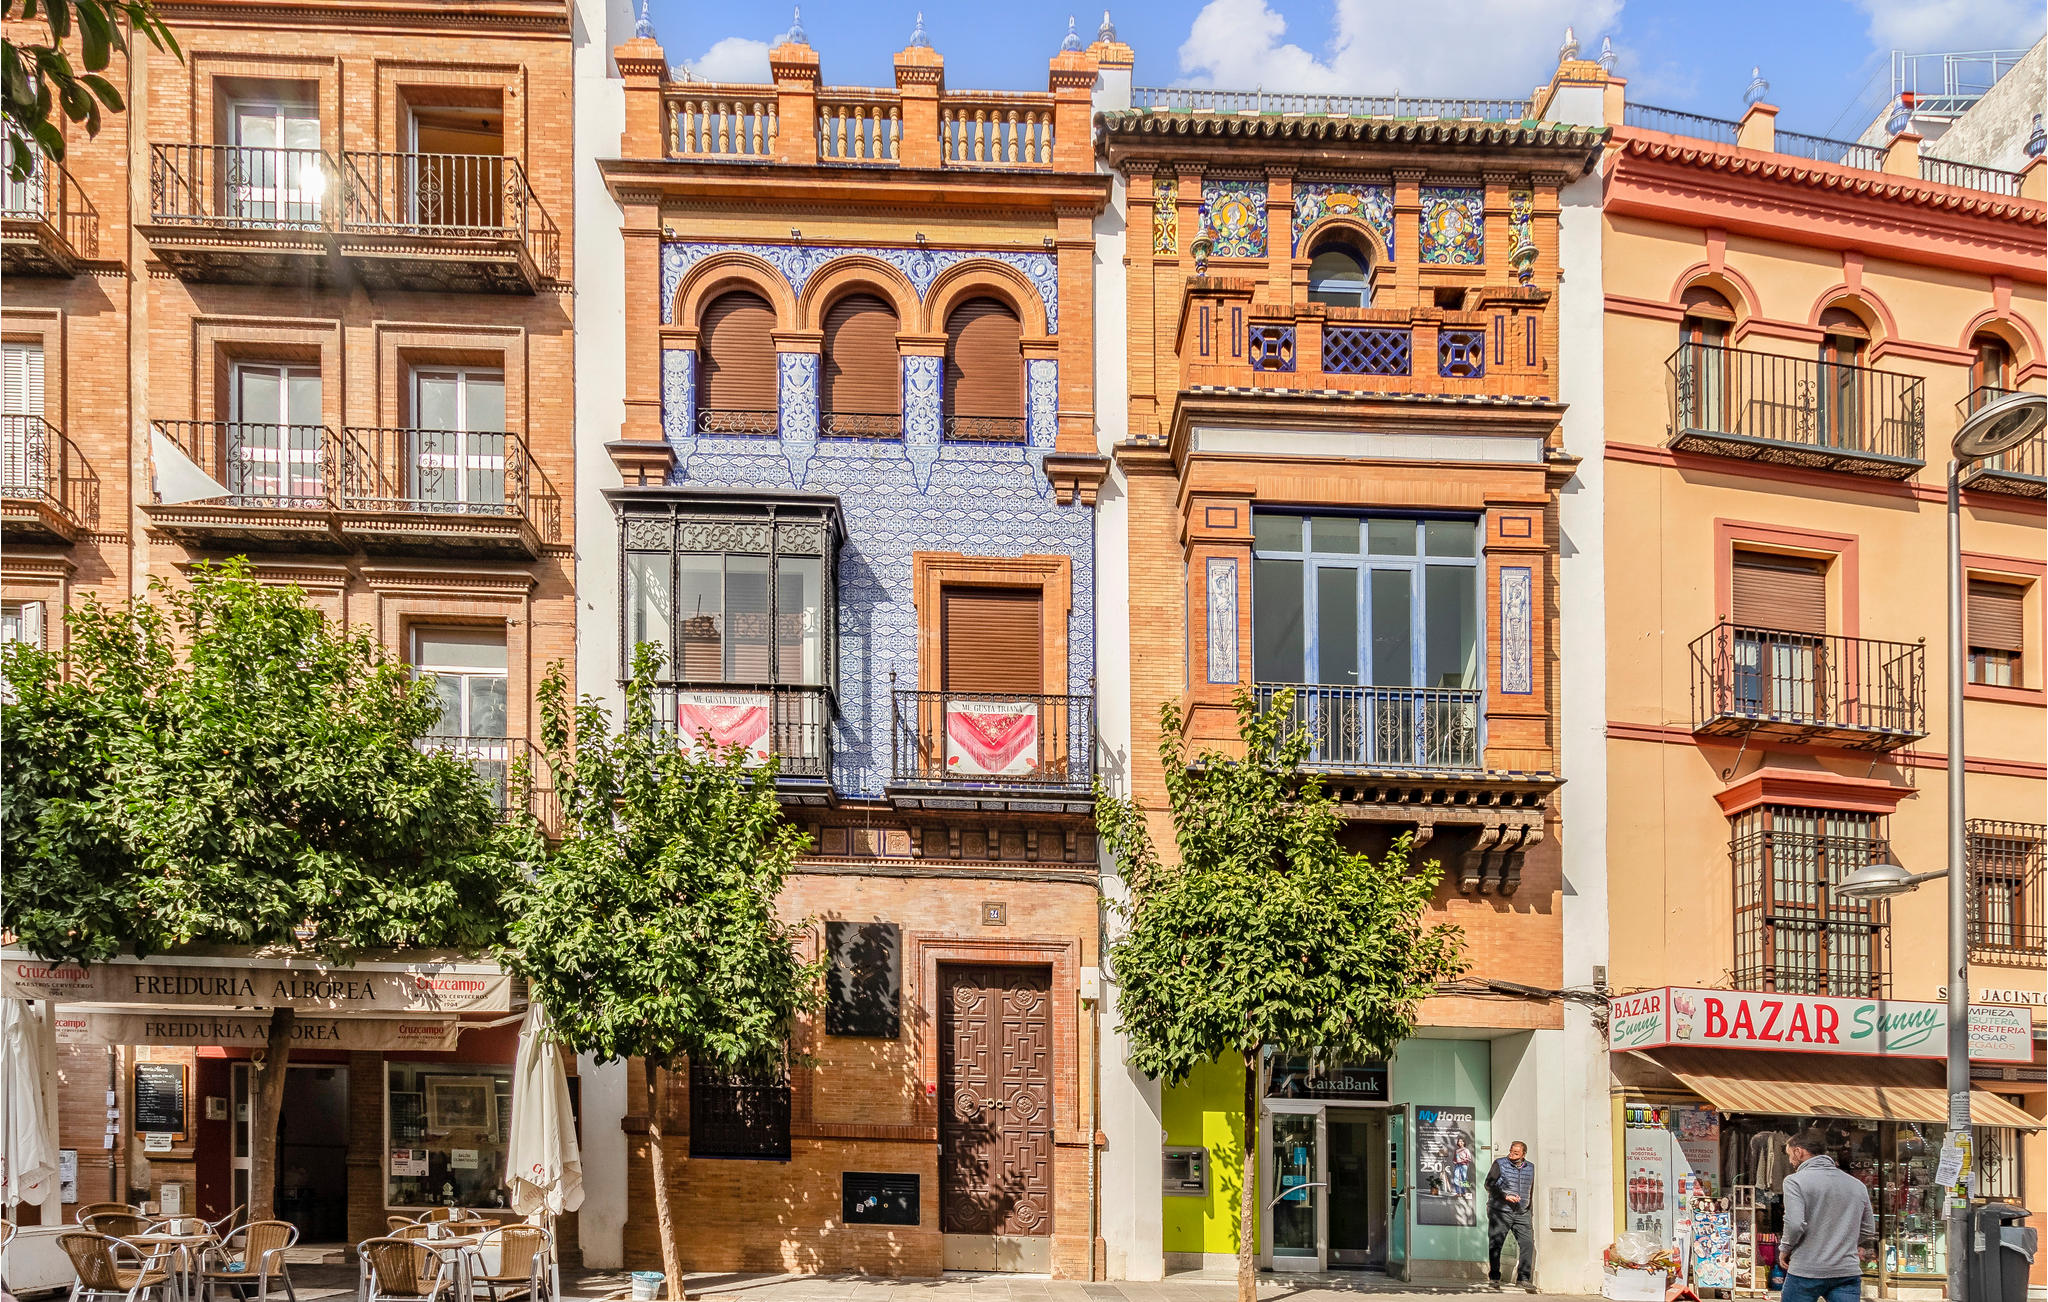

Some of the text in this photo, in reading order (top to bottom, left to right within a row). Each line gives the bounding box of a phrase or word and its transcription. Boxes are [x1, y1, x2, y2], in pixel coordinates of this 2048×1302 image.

[693, 695, 703, 703] ME
[705, 695, 727, 704] GUSTA
[961, 703, 1023, 713] ME GUSTA TRIANA
[17, 964, 90, 982] Cruzcampo
[134, 975, 376, 1000] FREIDURIA ALBOREÁ
[415, 976, 486, 993] Cruzcampo
[1614, 996, 1661, 1019] BAZAR
[1968, 1008, 2015, 1017] MPIEZA
[55, 1019, 87, 1029] zcampo
[1703, 997, 1945, 1050] BAZAR Sunny
[1968, 1016, 2020, 1026] ISUTERIA
[145, 1020, 341, 1040] FREIDURÍA AOREÁ
[399, 1025, 444, 1035] Cruzcampo
[1613, 1015, 1662, 1045] Sunny
[1968, 1024, 2027, 1035] ERRETERIA
[1968, 1033, 2008, 1042] OGAR
[1968, 1041, 2016, 1050] EGALOS
[1968, 1048, 1985, 1056] TC.
[1304, 1074, 1379, 1091] CaixaBank
[1419, 1110, 1472, 1123] MyHome
[1420, 1161, 1443, 1173] 250
